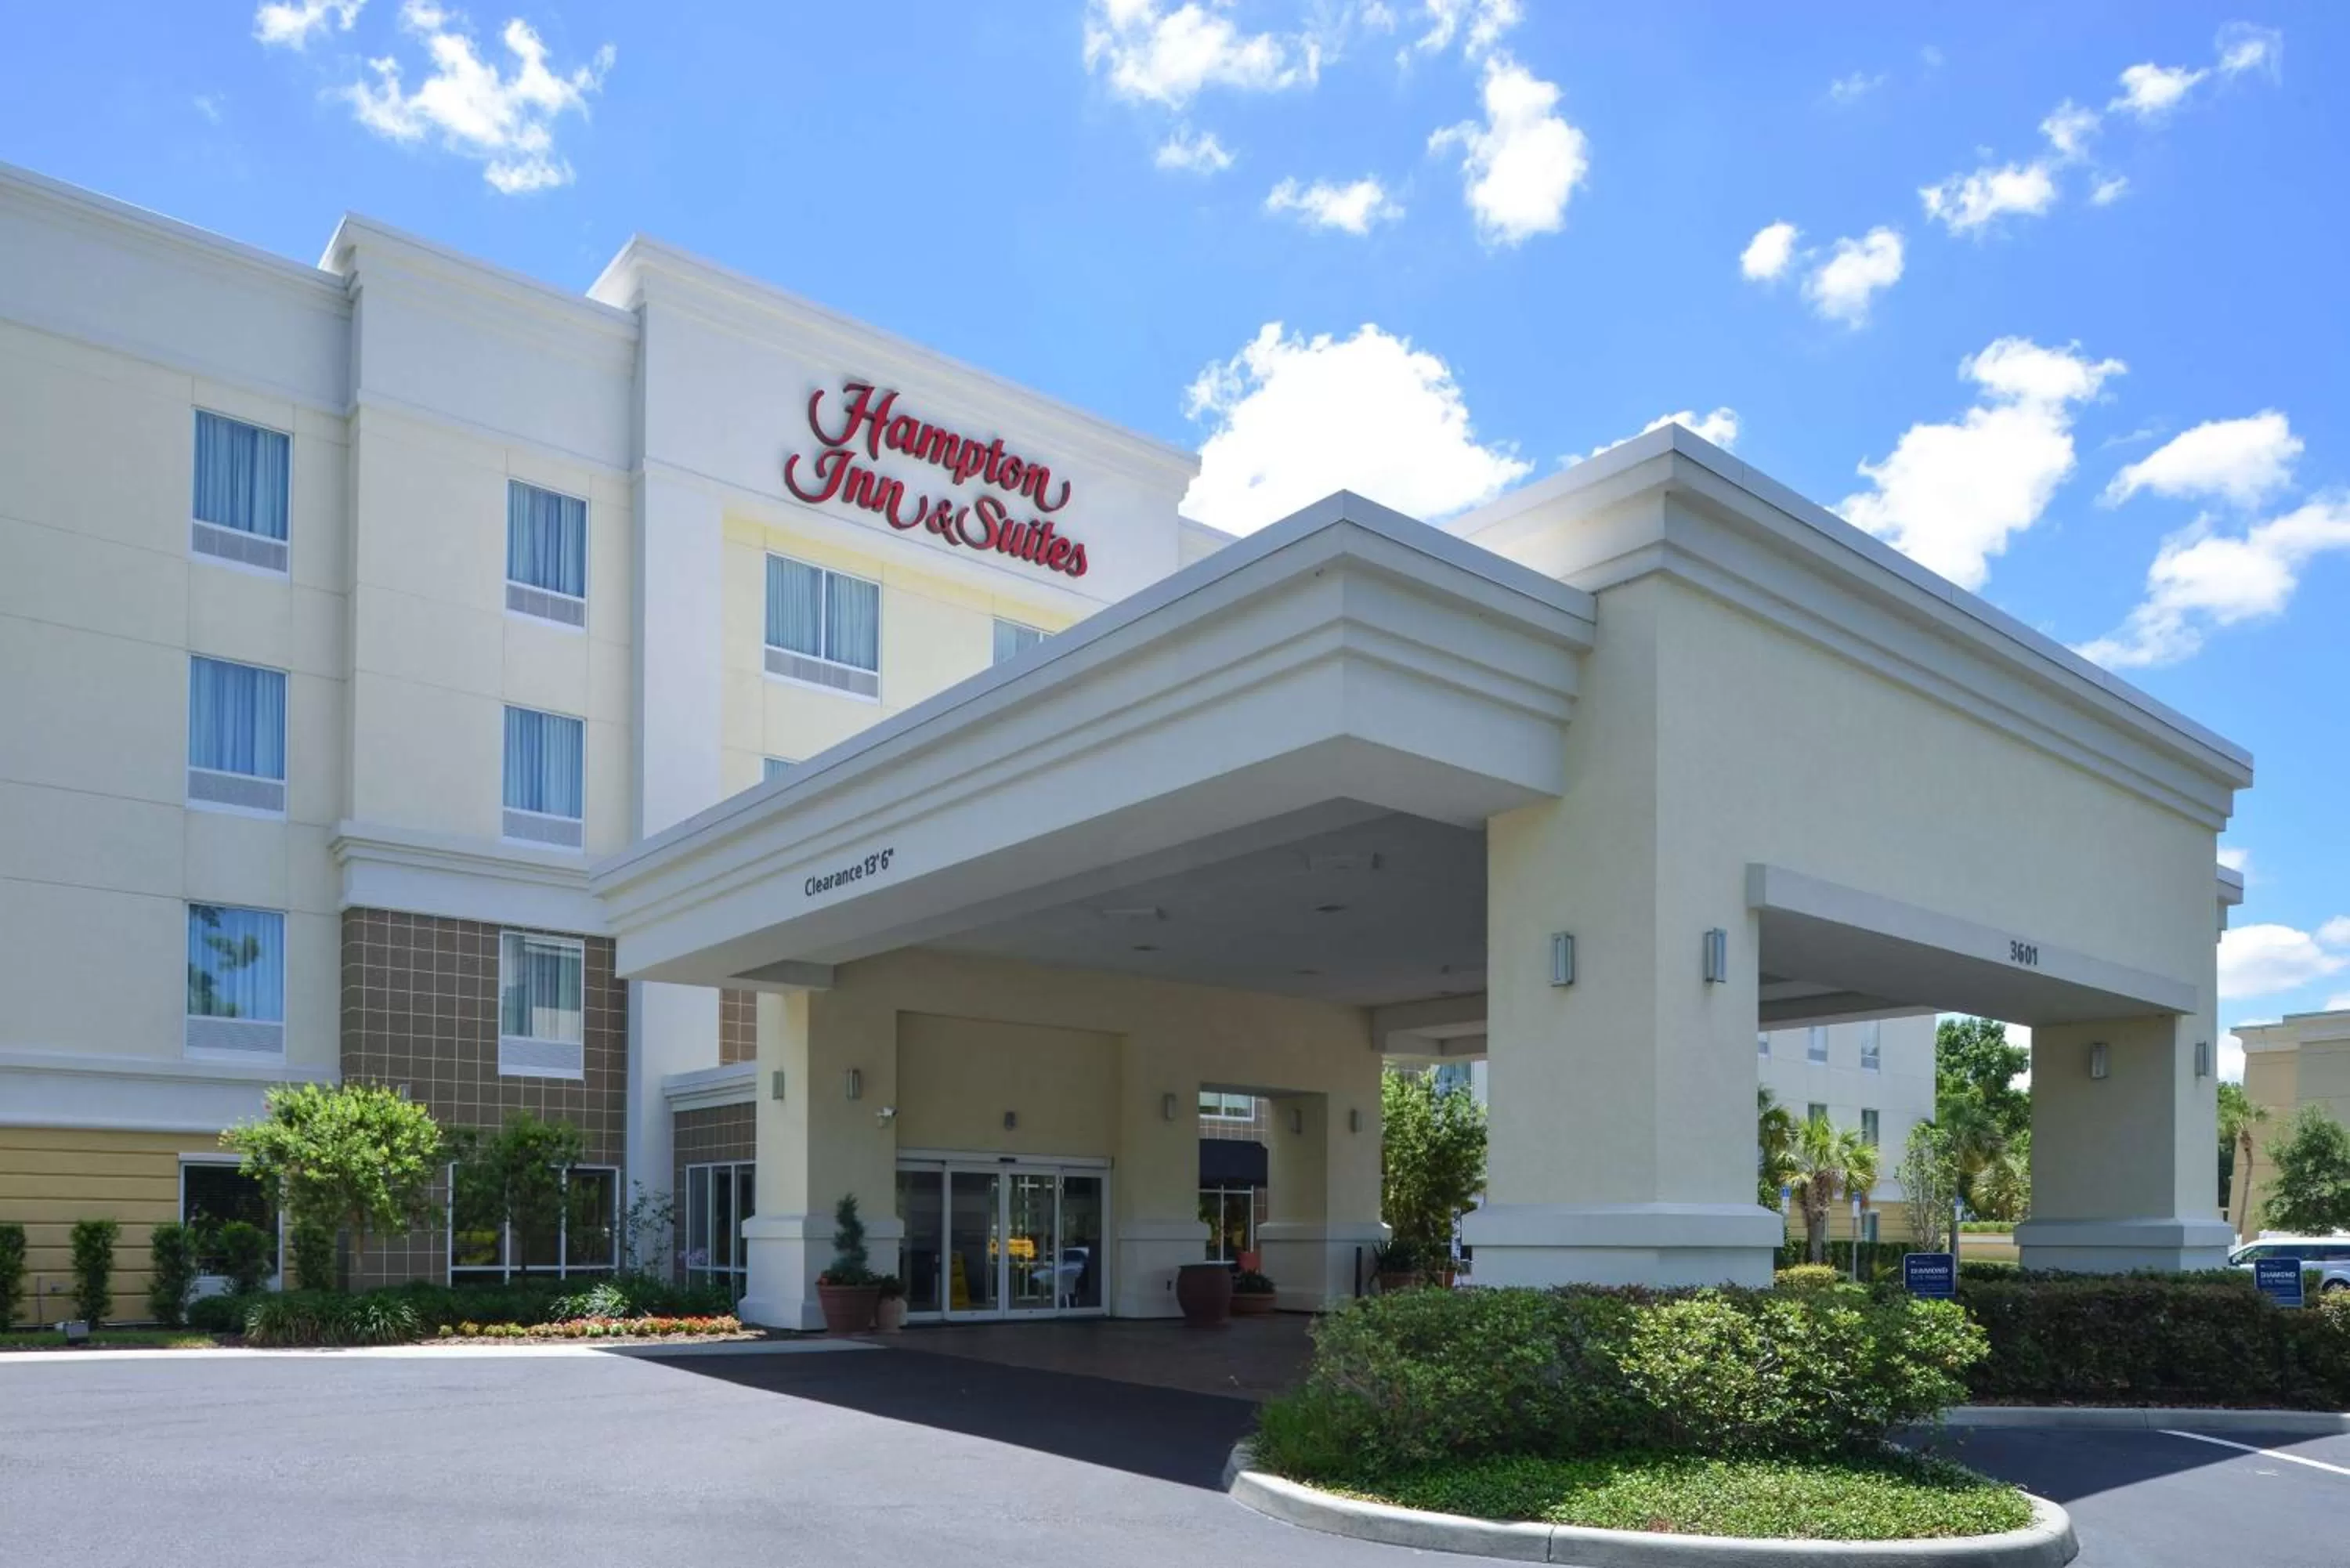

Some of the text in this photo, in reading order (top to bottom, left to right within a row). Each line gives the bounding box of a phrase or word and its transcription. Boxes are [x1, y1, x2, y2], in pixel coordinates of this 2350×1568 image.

[808, 383, 1071, 513] Hampton
[785, 449, 928, 530] Inn
[956, 495, 1088, 577] Suites
[804, 865, 862, 897] Clearance
[2009, 940, 2038, 966] 3601
